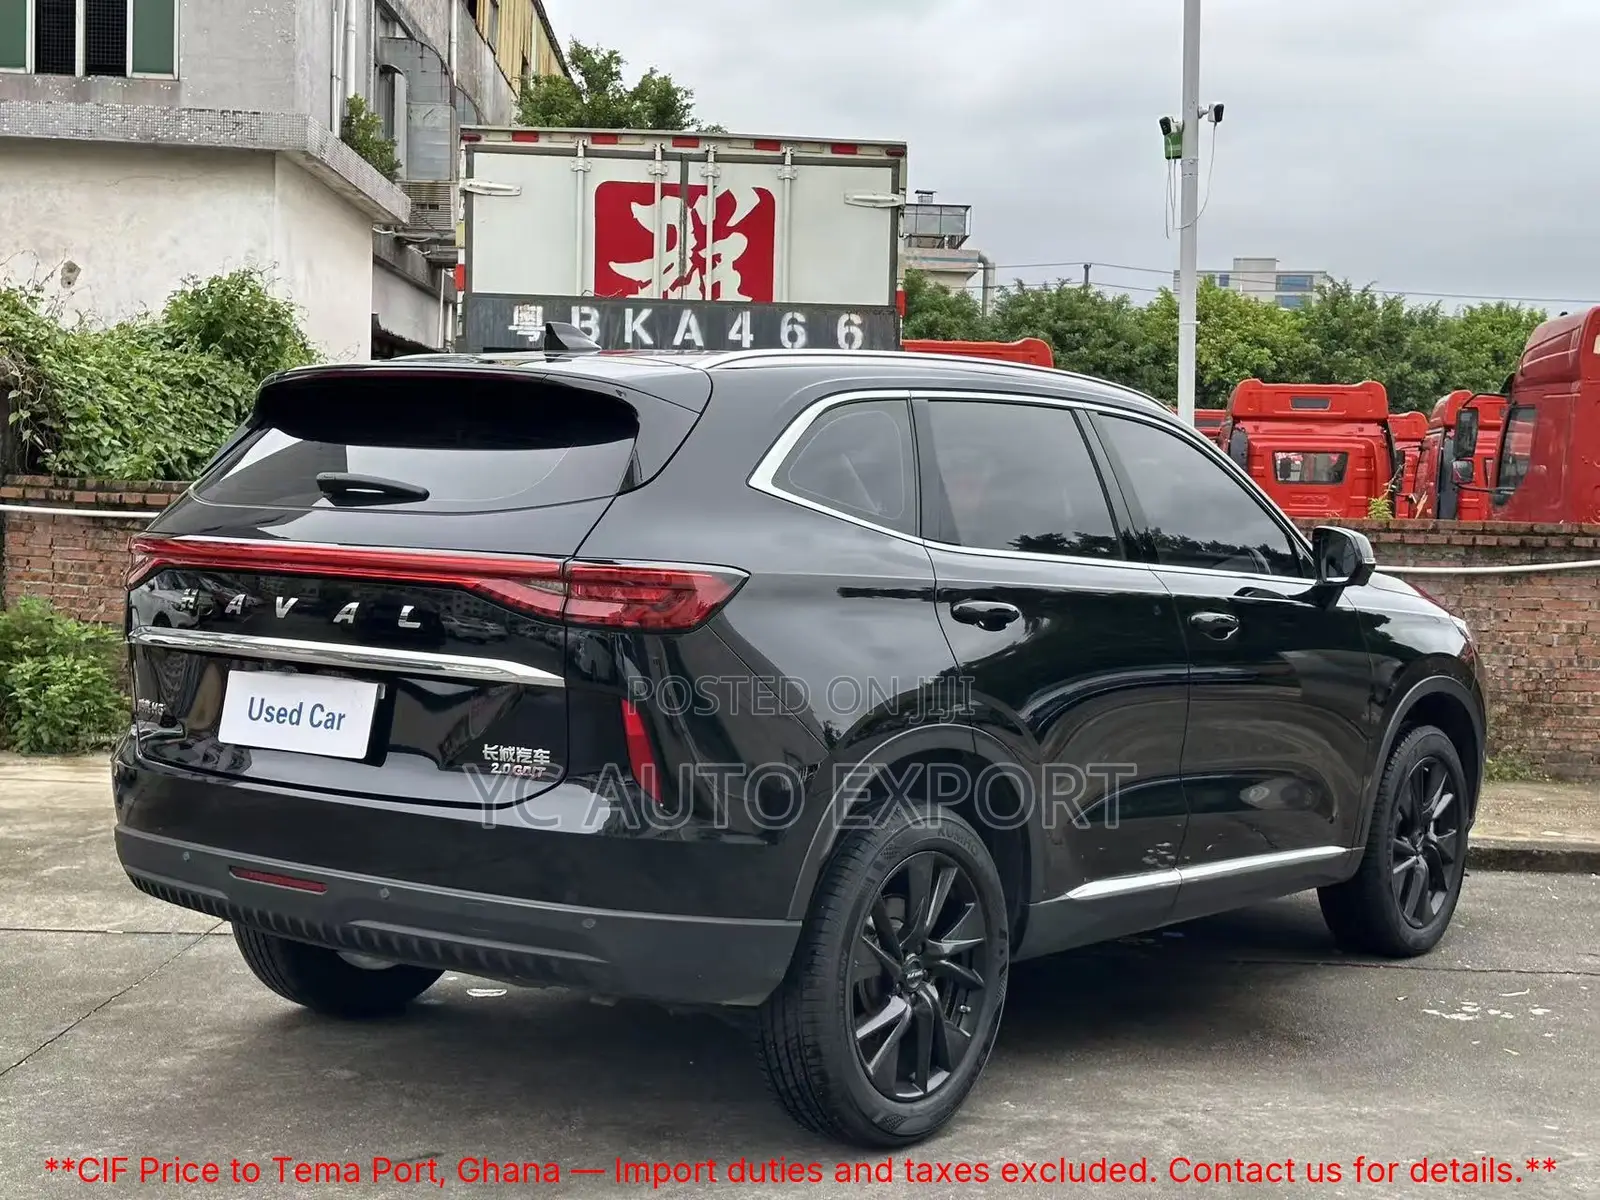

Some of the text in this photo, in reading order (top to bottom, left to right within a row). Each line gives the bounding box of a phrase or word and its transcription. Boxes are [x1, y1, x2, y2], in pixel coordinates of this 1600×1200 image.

[181, 588, 421, 629] HAVAL
[247, 696, 346, 731] Used Car
[482, 743, 551, 765] 长城汽车
